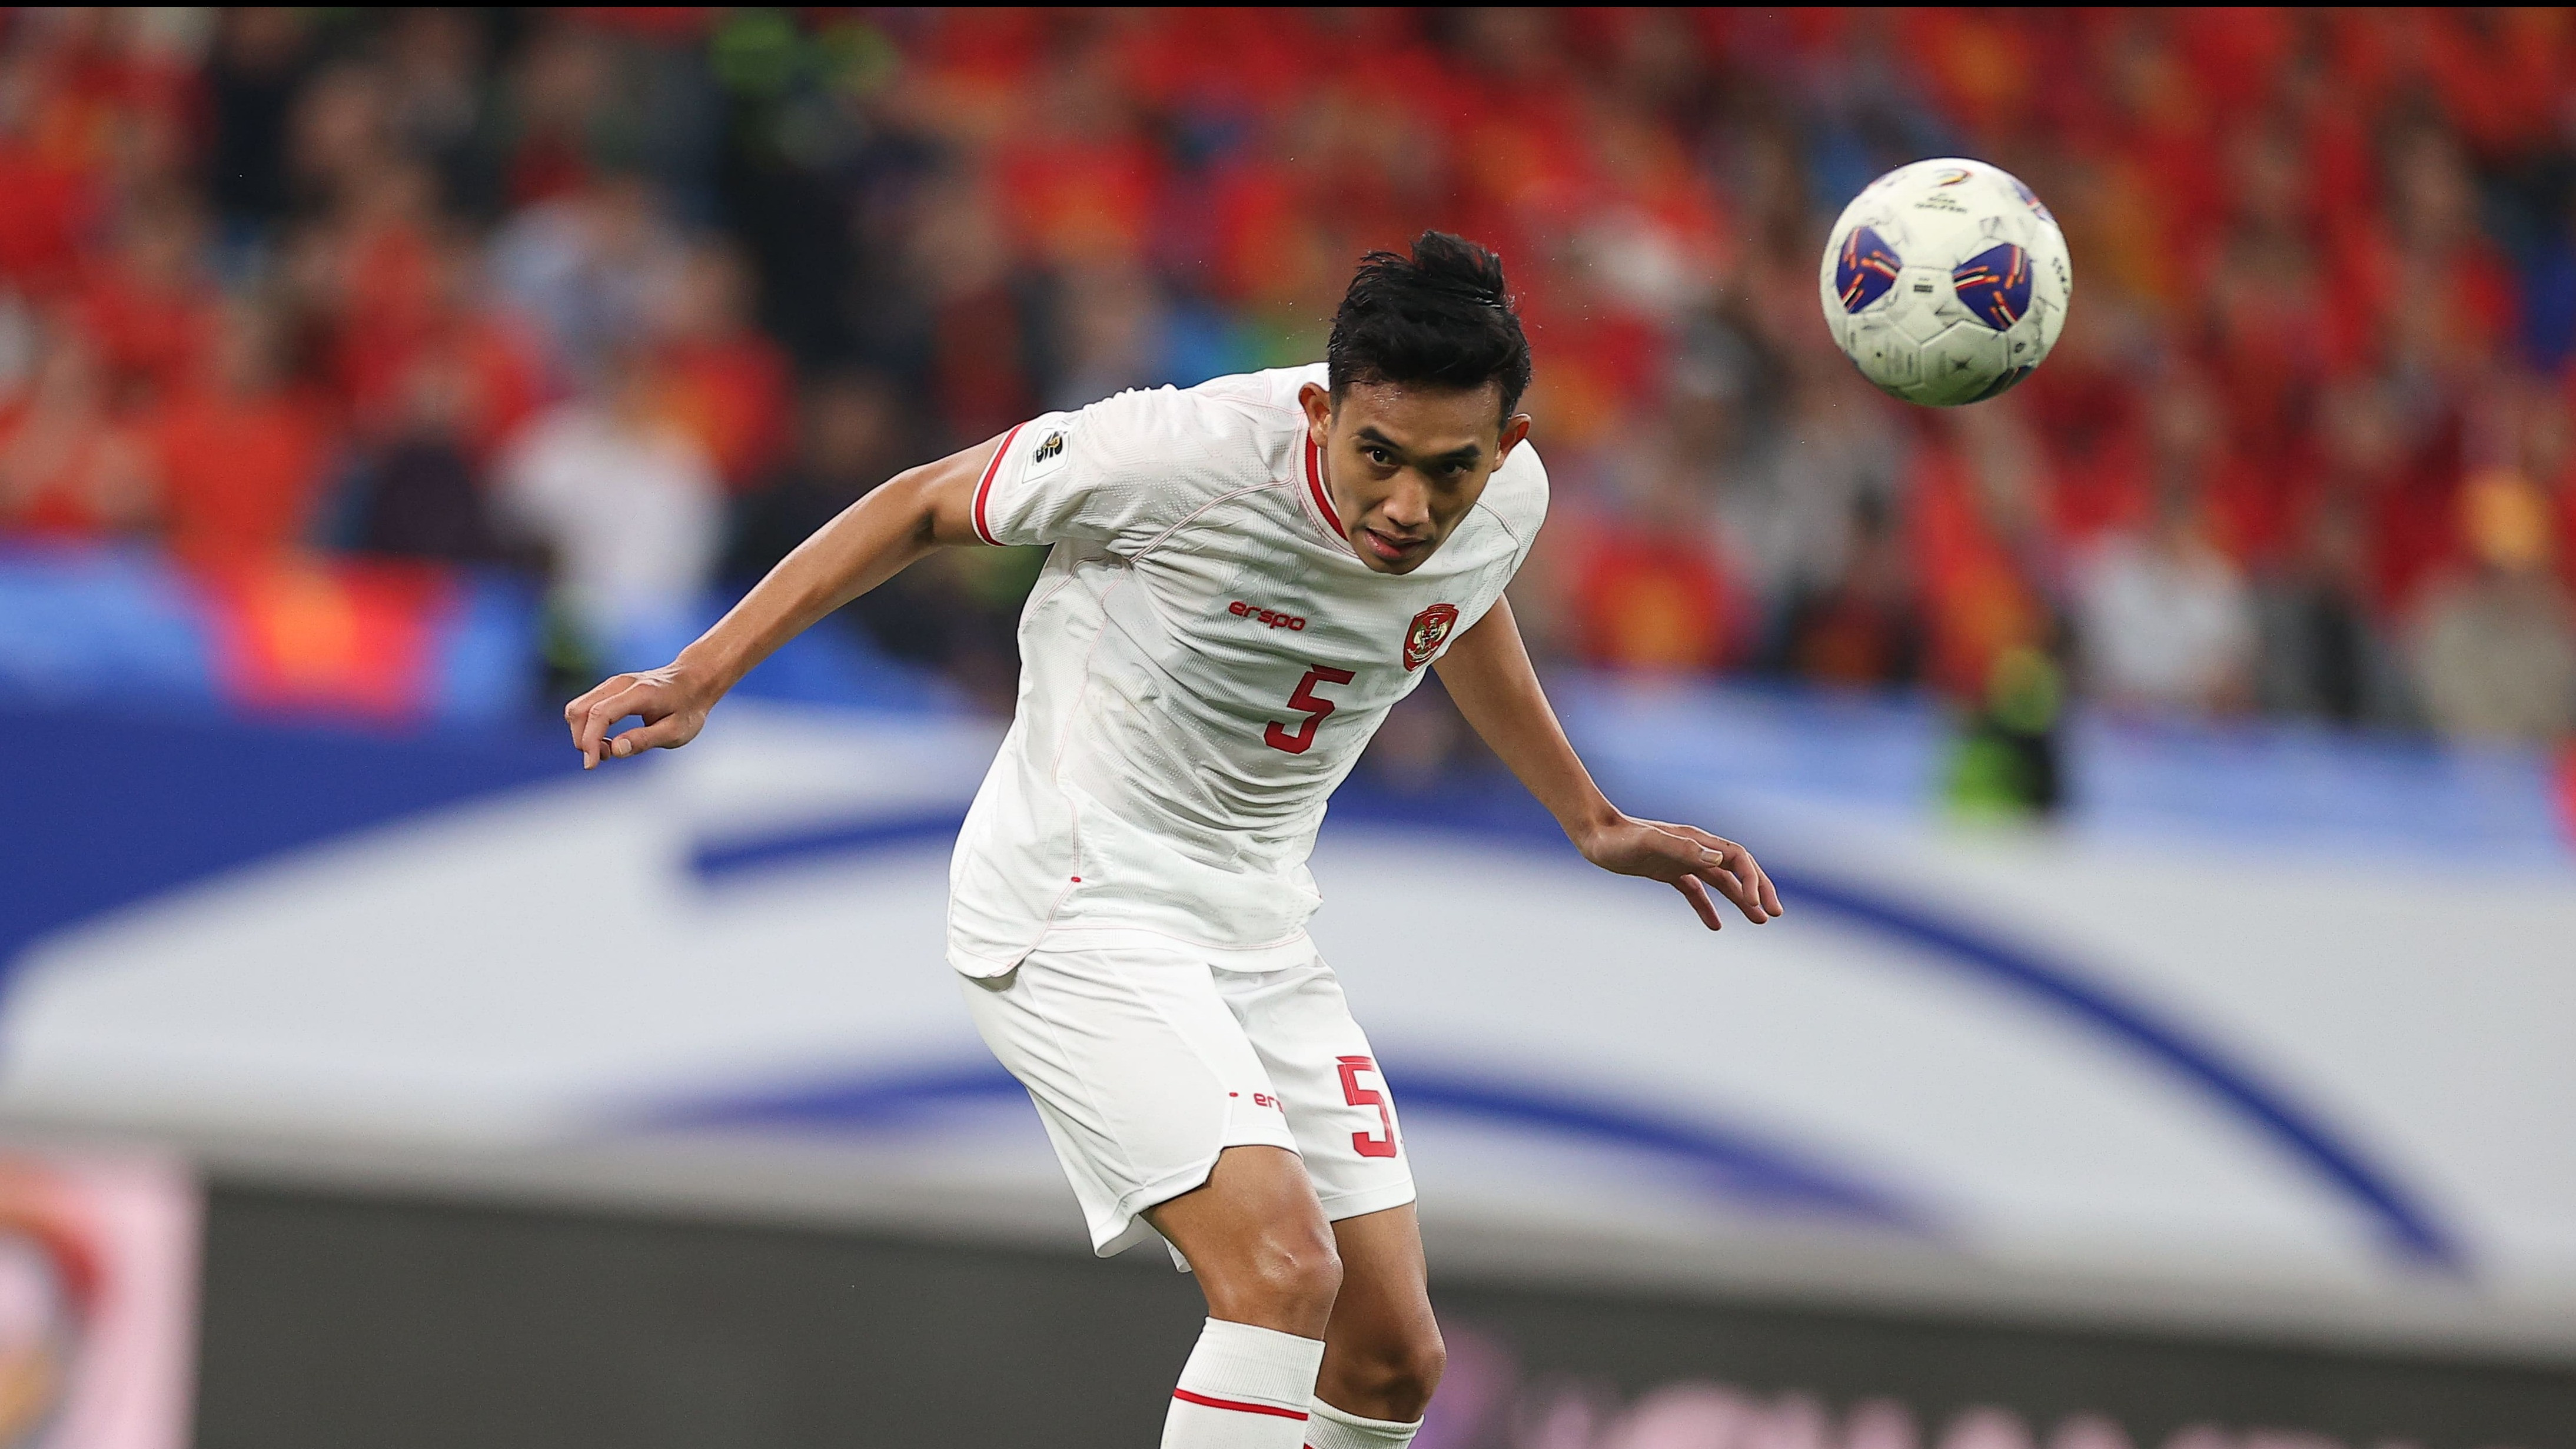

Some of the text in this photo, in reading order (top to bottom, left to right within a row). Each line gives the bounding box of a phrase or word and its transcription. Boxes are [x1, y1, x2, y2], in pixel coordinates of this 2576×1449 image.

[1228, 601, 1306, 631] erspo
[1264, 663, 1356, 755] 5
[1335, 1055, 1396, 1158] 5
